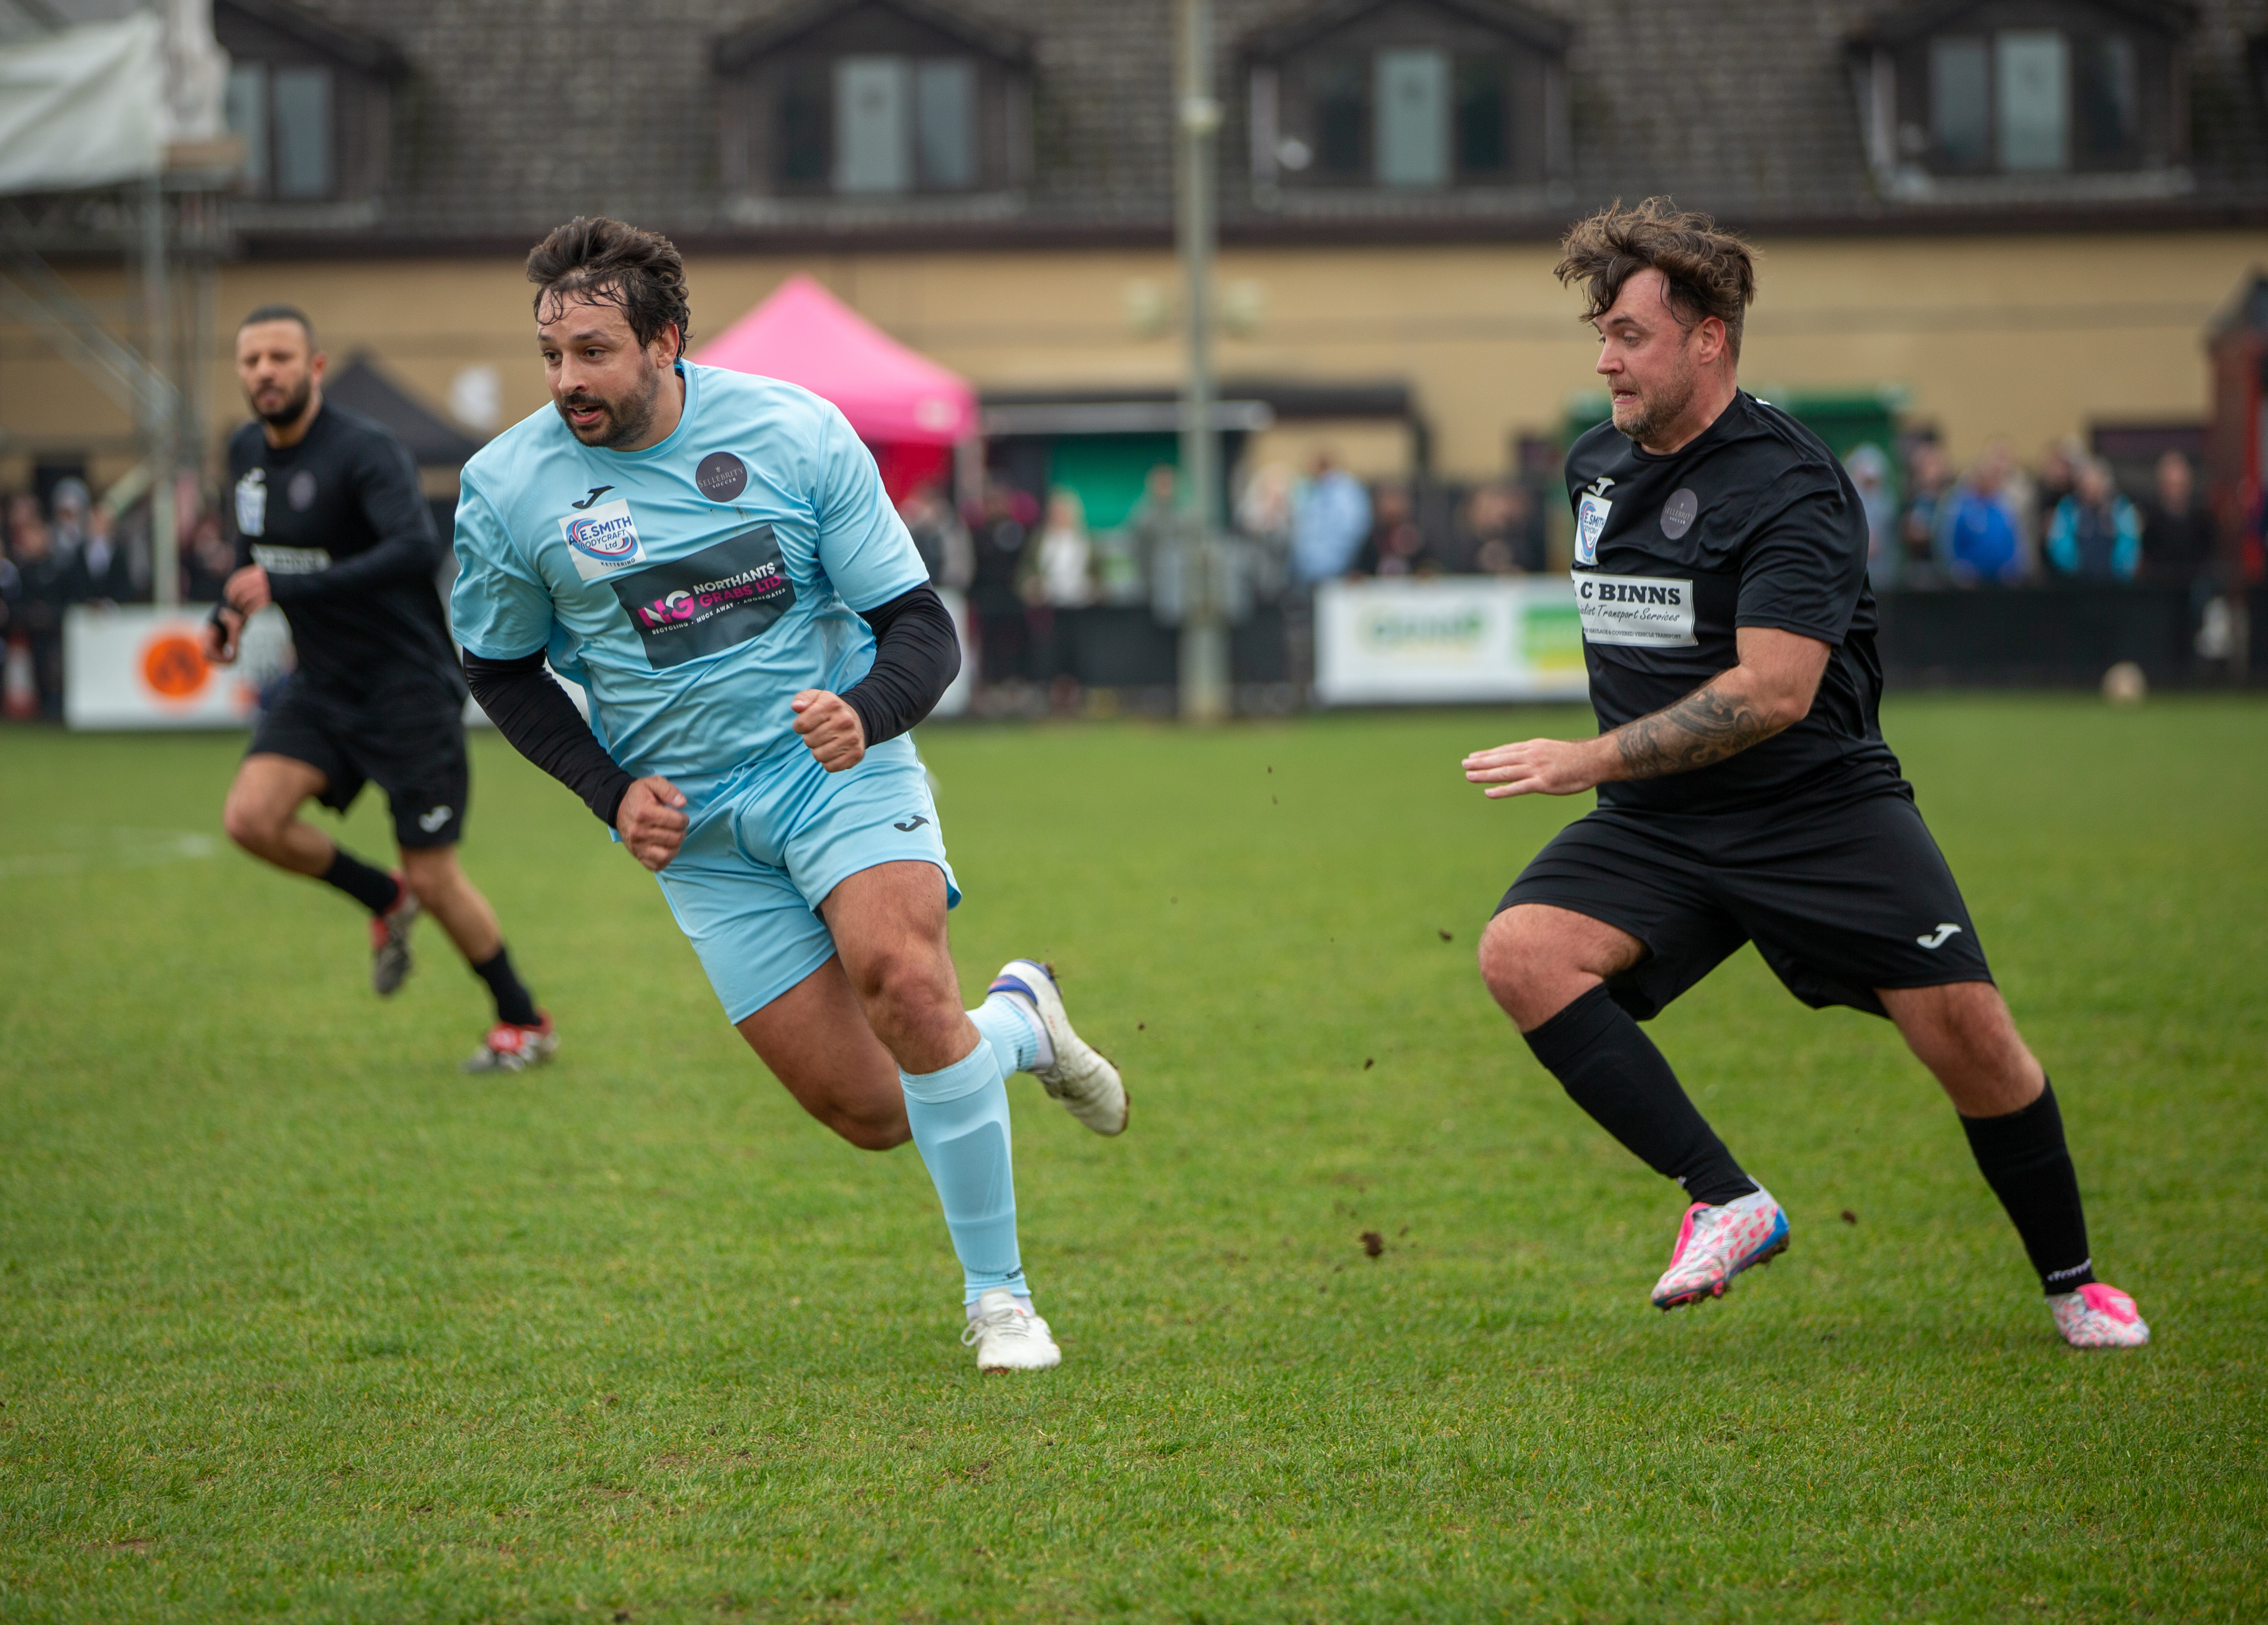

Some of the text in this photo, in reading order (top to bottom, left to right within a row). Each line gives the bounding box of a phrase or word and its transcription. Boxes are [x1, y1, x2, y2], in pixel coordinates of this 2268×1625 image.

[698, 467, 743, 488] SELLEBRITY
[712, 477, 736, 489] SOCCER
[568, 516, 632, 545] A.E.SMITH
[580, 529, 626, 550] BODYCRAFT
[605, 541, 617, 550] Ltd
[600, 557, 635, 567] KETTERING
[693, 562, 776, 595] NORTHANTS
[699, 575, 781, 607] GRABS LTD
[1580, 581, 1593, 599] C
[1599, 583, 1681, 606] BINNS
[652, 588, 786, 635] RECYCLING MUCK AWAY AGGREGATES
[1579, 603, 1680, 623] ialist Transport Services
